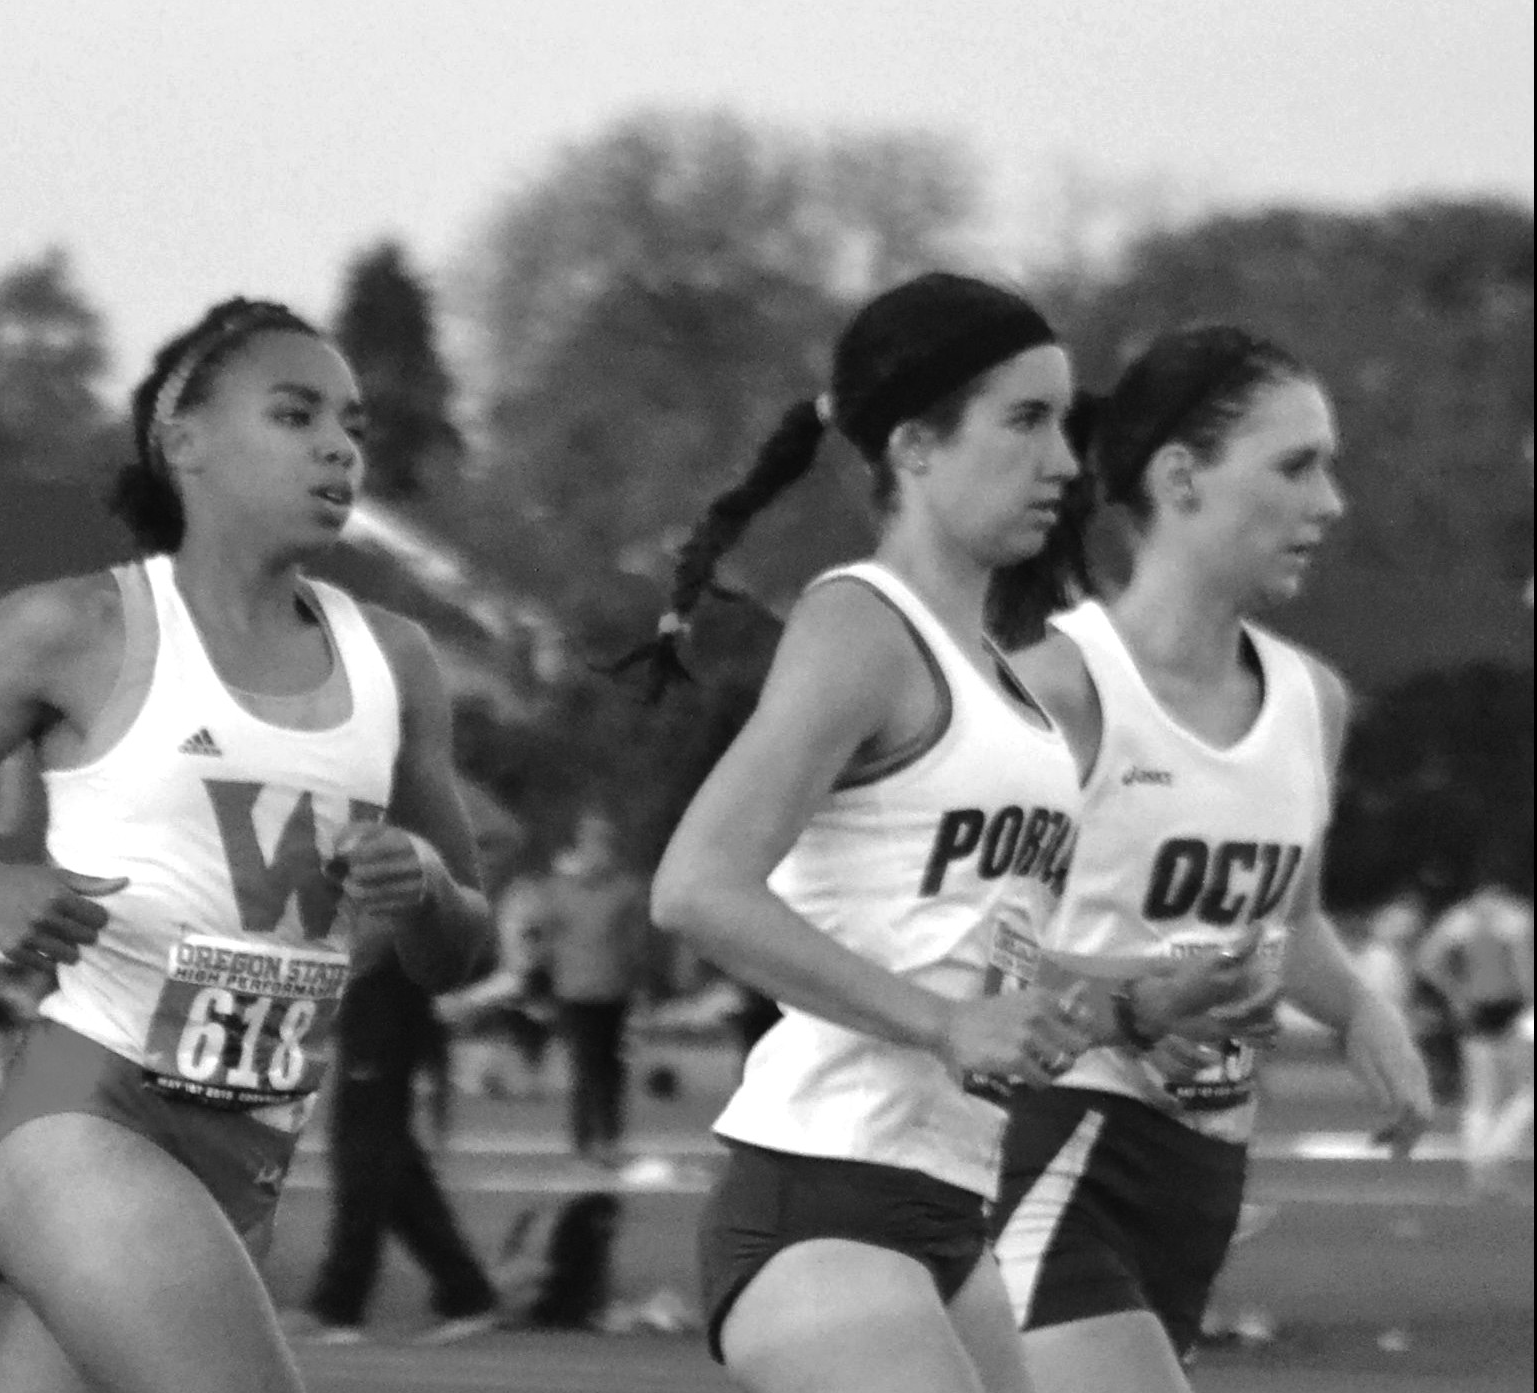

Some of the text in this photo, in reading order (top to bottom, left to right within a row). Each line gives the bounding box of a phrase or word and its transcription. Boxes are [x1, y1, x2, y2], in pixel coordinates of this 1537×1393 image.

[175, 967, 221, 983] HIGH
[176, 944, 283, 981] OREGON
[176, 986, 317, 1091] 618
